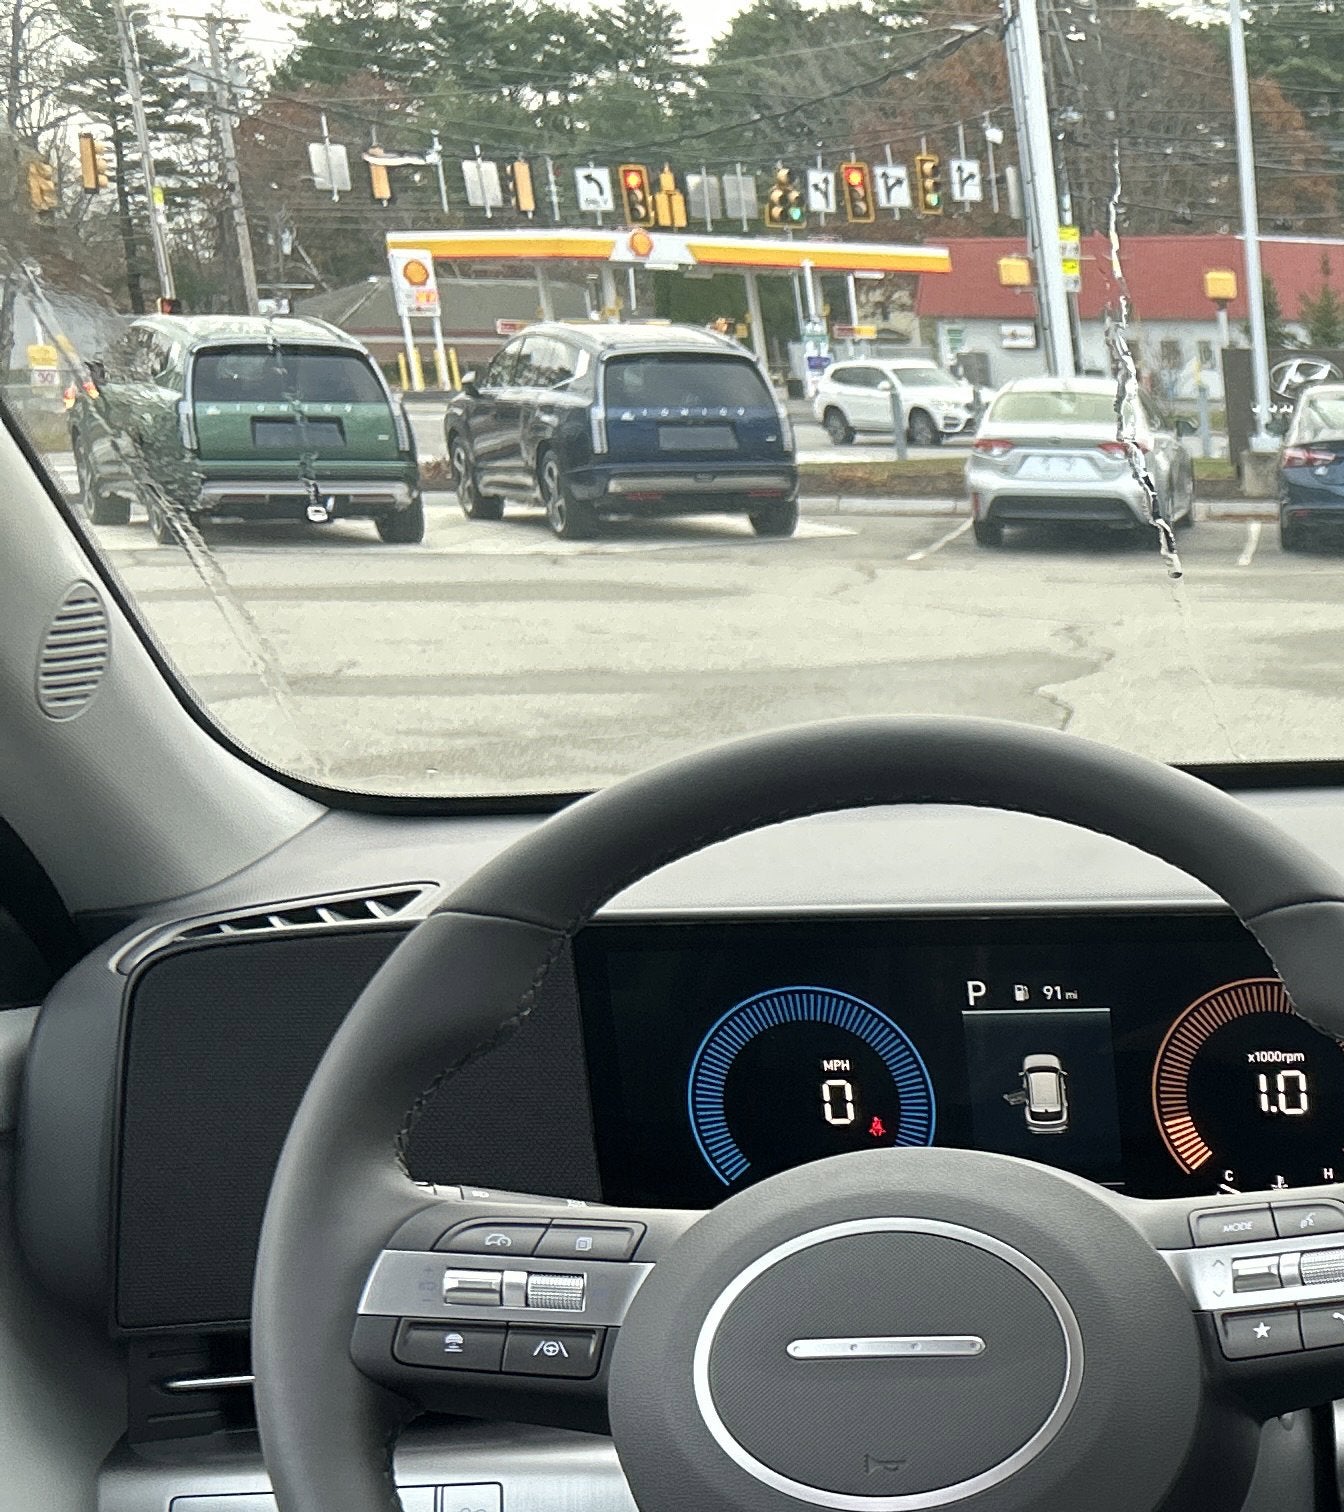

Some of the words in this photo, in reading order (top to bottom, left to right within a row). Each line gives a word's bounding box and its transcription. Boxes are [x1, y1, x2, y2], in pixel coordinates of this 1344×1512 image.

[967, 980, 987, 1006] P
[1042, 985, 1062, 1000] 91
[1065, 990, 1078, 1000] mi
[1247, 1050, 1305, 1064] x1000rpm
[823, 1059, 850, 1071] MPH
[1258, 1070, 1308, 1115] 1.0
[822, 1079, 855, 1125] 0
[1224, 1169, 1234, 1182] C
[1323, 1167, 1334, 1180] H
[1223, 1221, 1254, 1233] MODE
